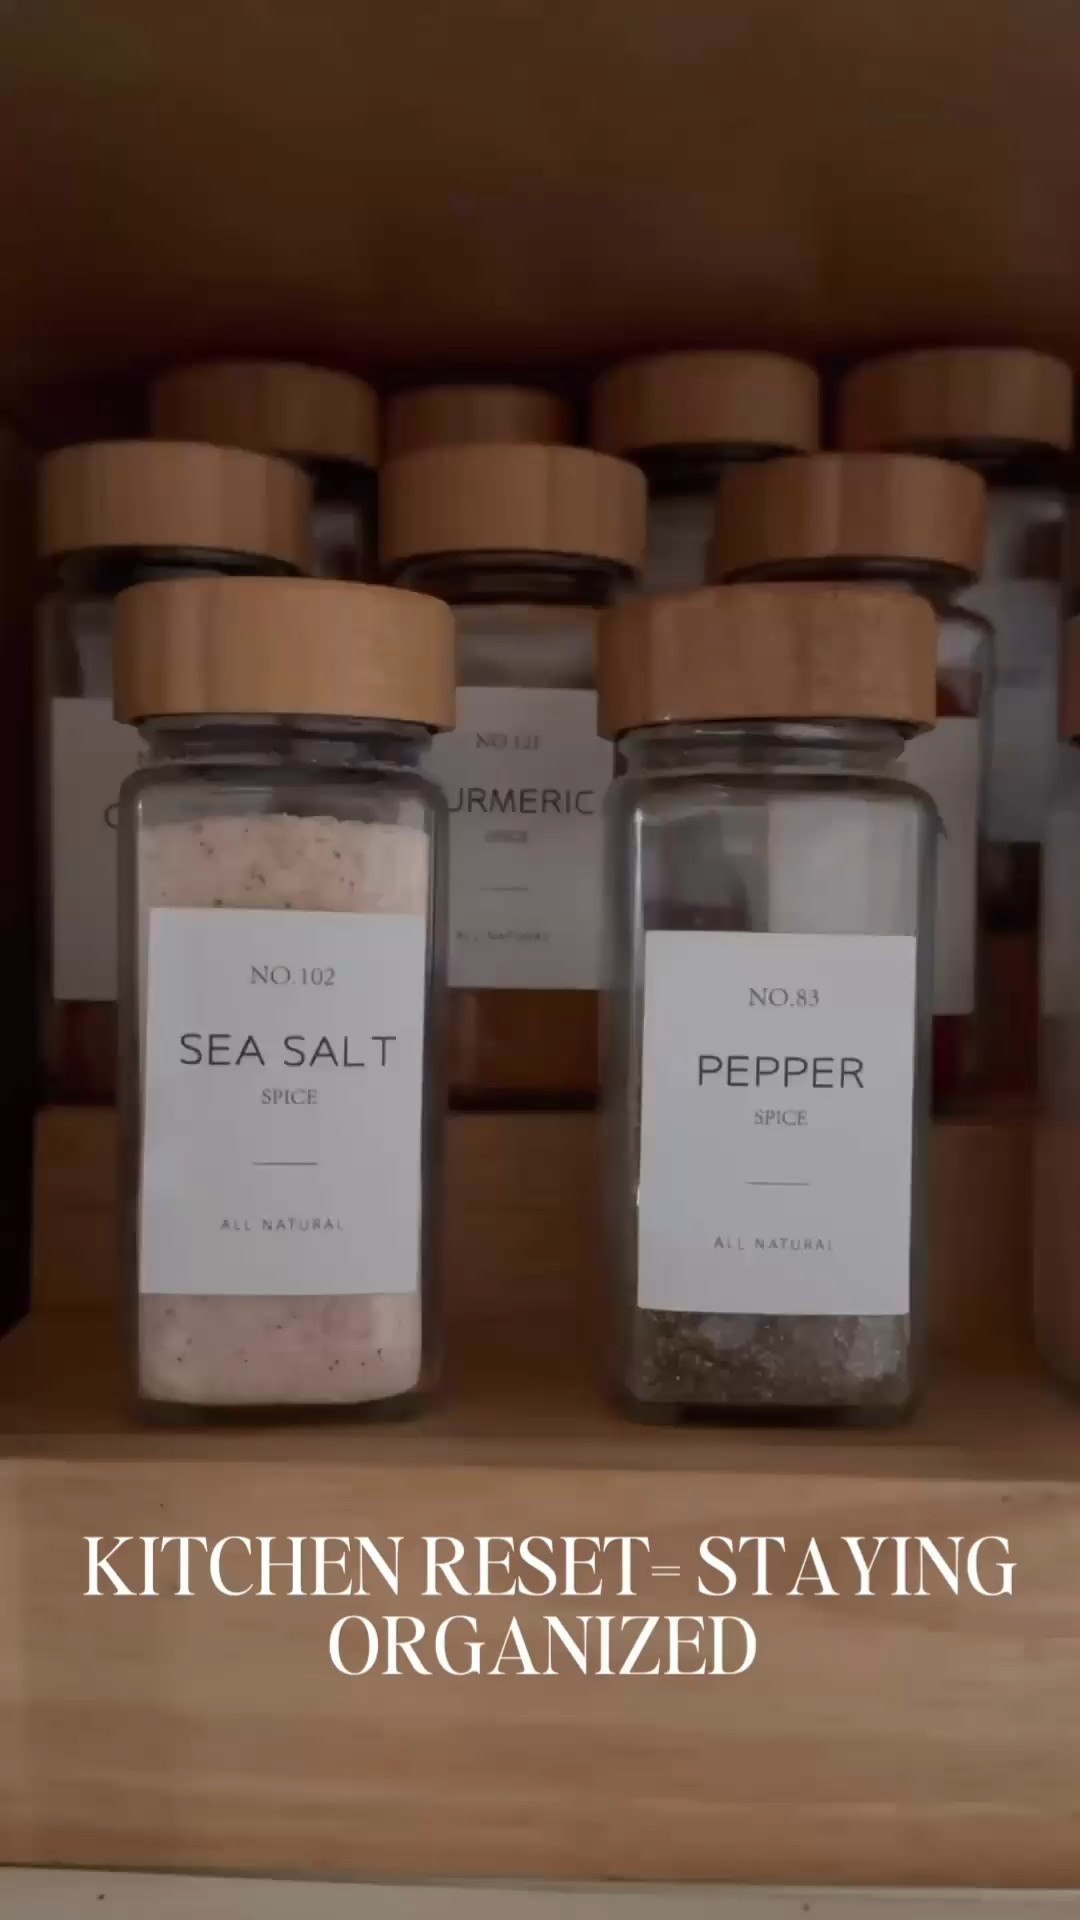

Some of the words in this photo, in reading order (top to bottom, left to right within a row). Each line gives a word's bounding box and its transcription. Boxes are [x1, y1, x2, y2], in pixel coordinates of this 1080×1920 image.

[449, 787, 595, 815] URMERIC
[250, 965, 336, 988] NO.102
[748, 987, 820, 1009] NO.83
[179, 1032, 266, 1068] SEA
[283, 1035, 398, 1068] SALT
[698, 1054, 865, 1090] PEPPER
[260, 1087, 319, 1106] SPICE
[752, 1109, 810, 1127] SPICE
[219, 1218, 252, 1233] ALL
[261, 1217, 344, 1234] NATURAL
[713, 1235, 746, 1251] ALL
[754, 1236, 834, 1252] NATURAL
